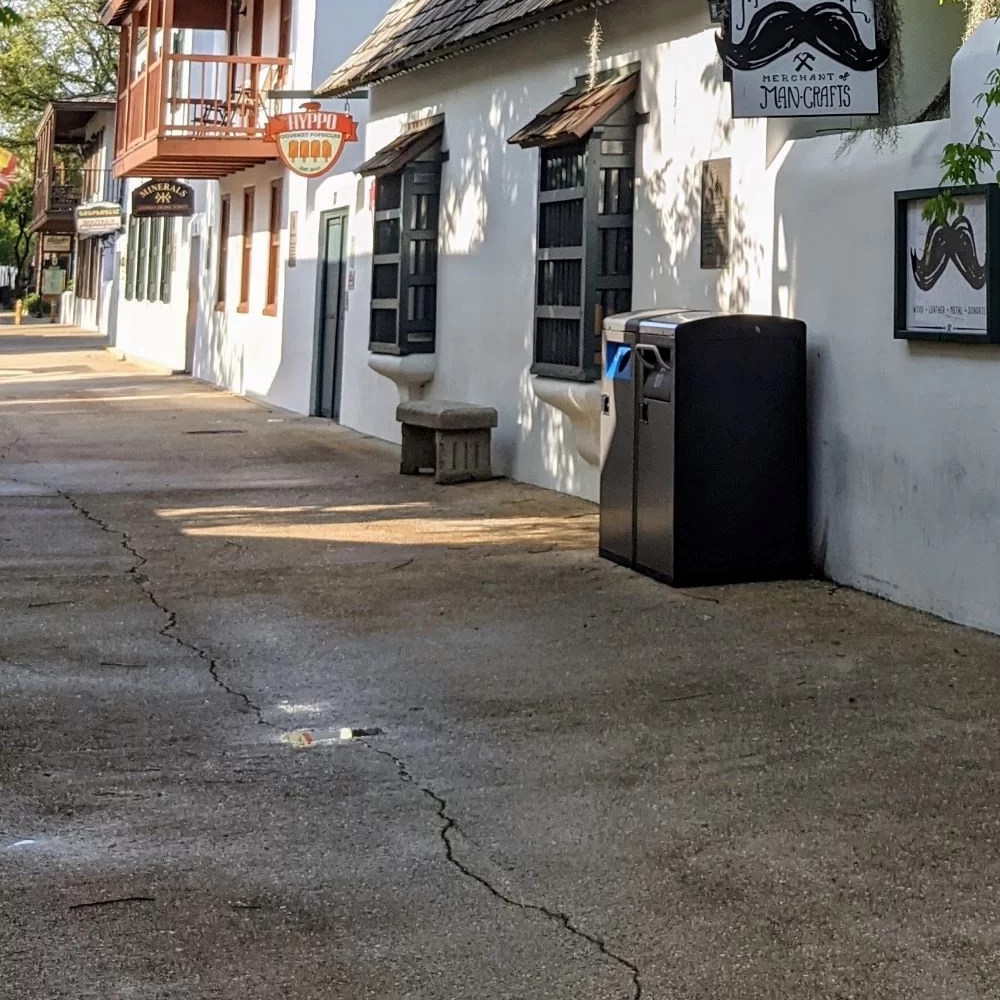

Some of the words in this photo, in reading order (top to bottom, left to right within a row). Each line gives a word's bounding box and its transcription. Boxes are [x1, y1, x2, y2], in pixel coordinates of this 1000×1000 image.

[762, 72, 835, 82] MERCHANT
[288, 112, 338, 131] HYPPO
[139, 182, 188, 199] MINERALS
